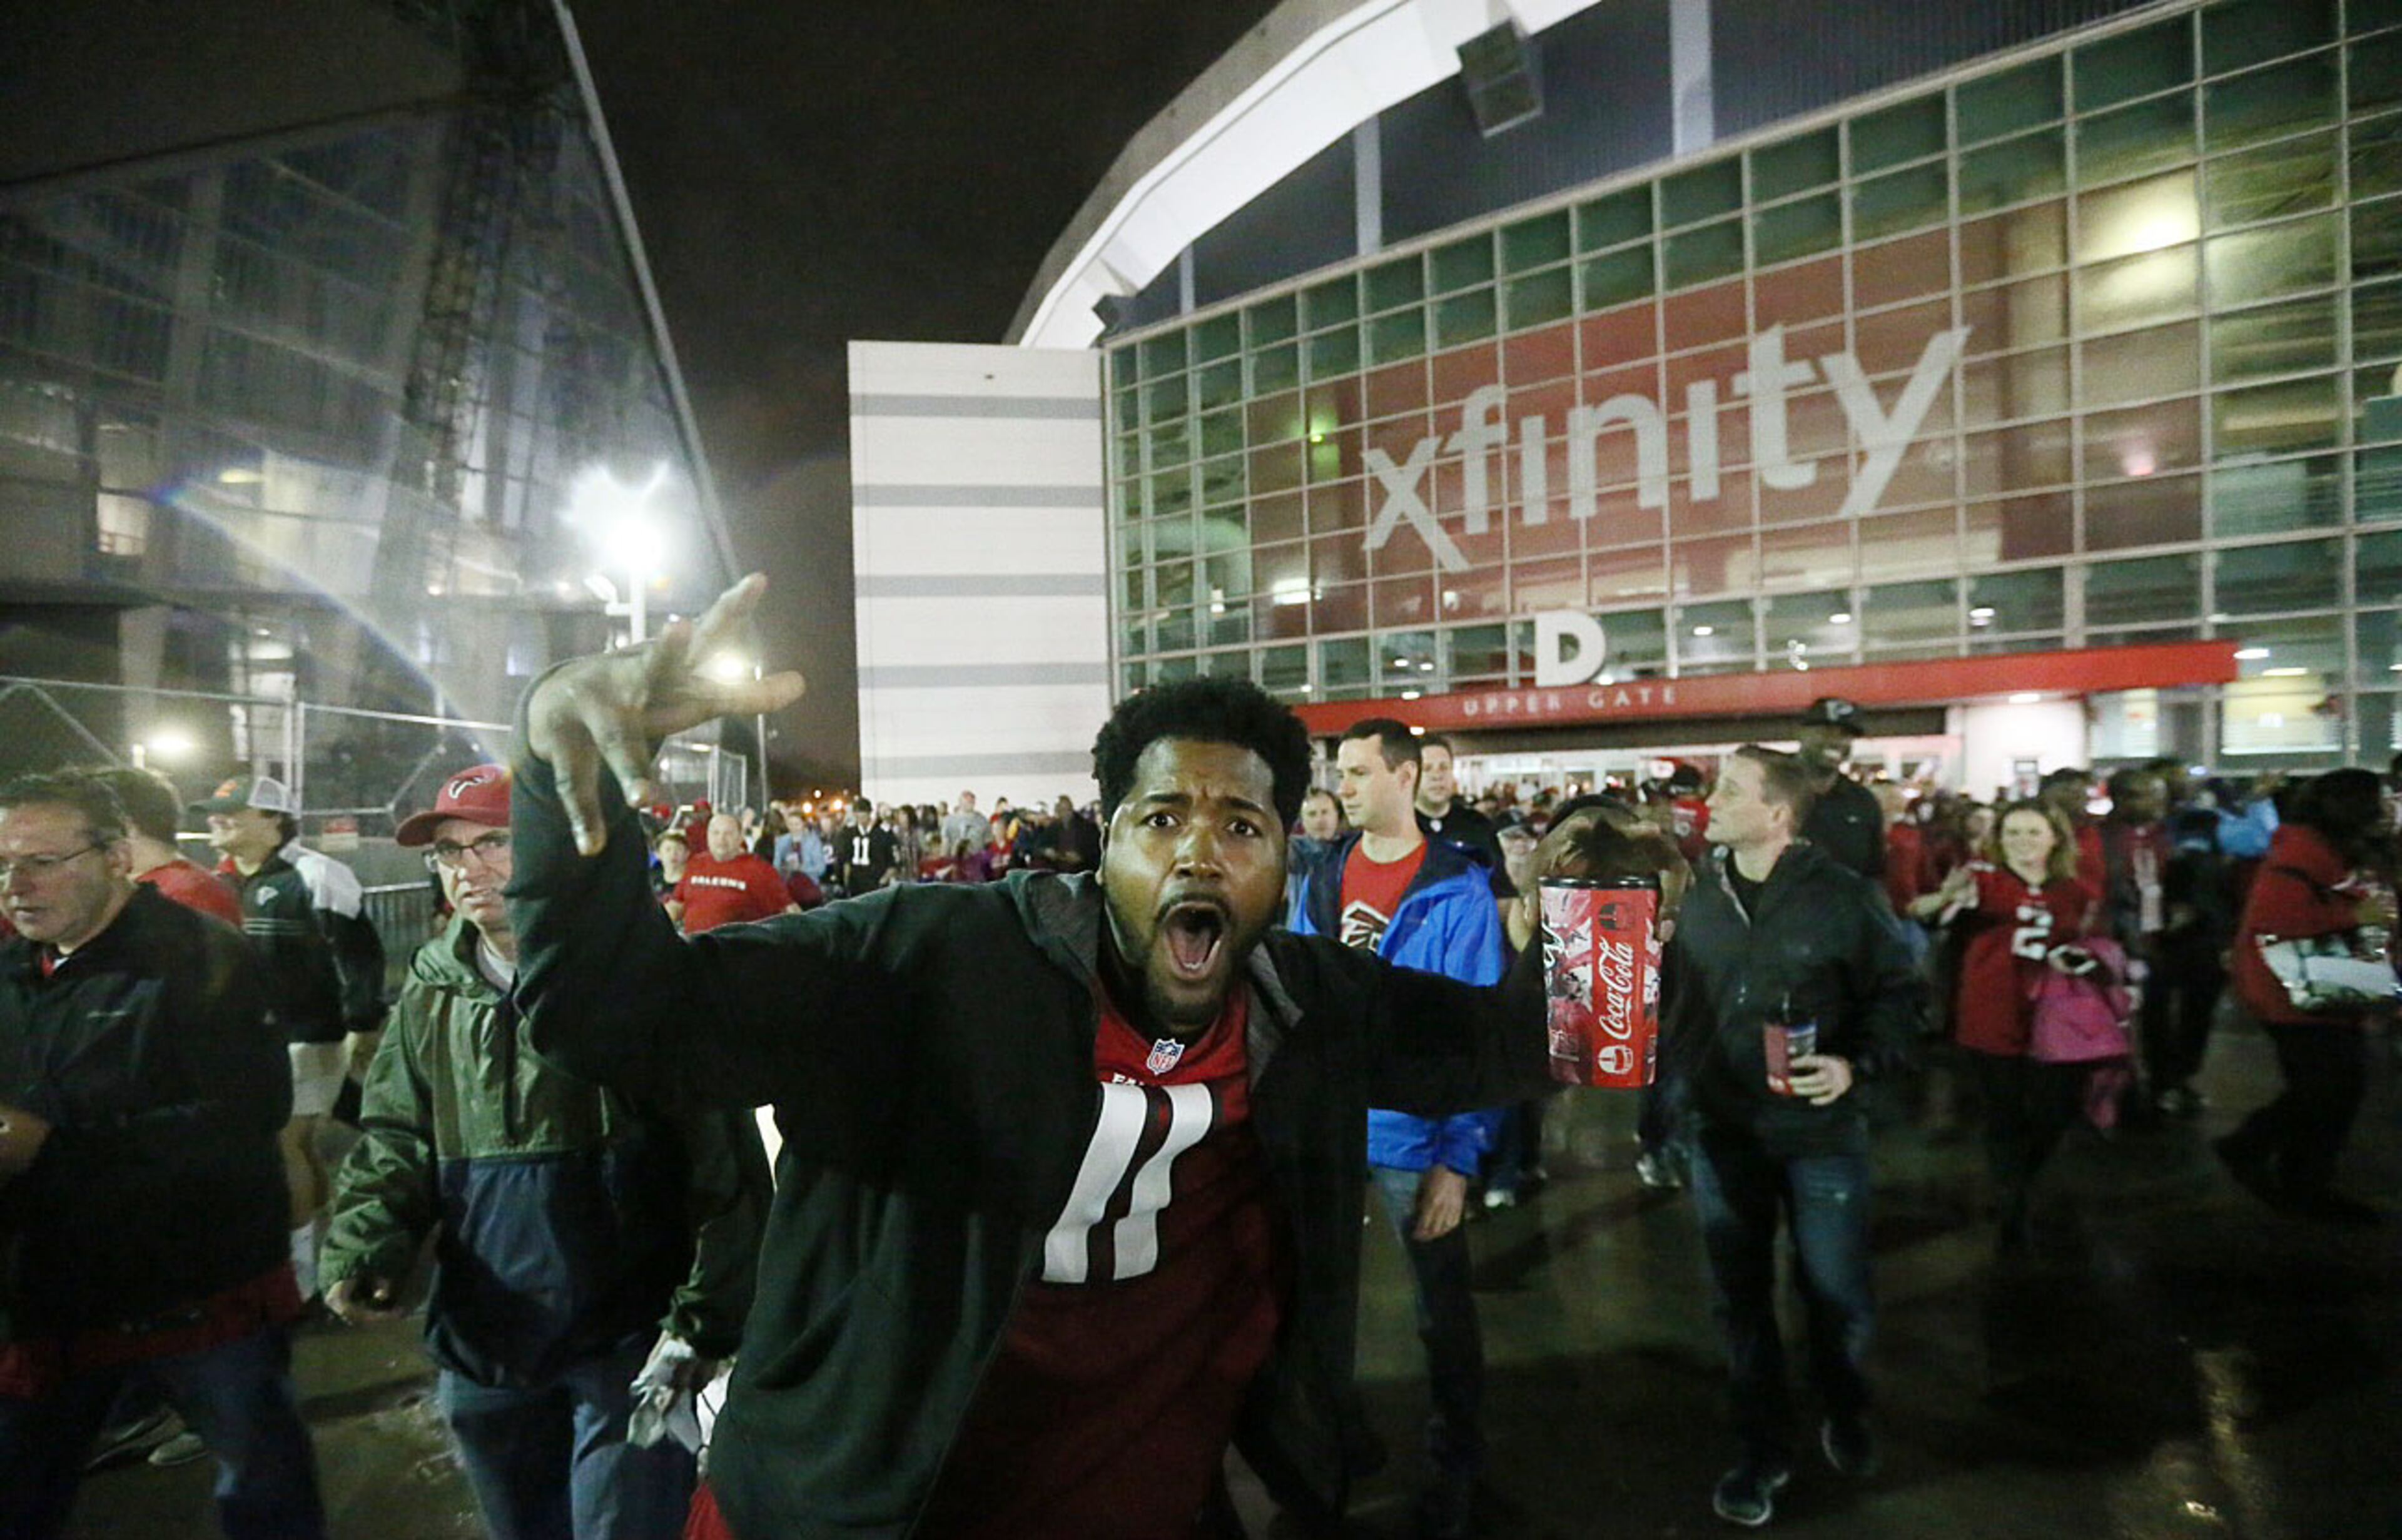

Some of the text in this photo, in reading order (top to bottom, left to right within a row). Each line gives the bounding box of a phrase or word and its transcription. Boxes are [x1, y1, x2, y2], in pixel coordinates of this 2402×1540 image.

[1361, 322, 1974, 572] xfinity
[1534, 609, 1606, 687] D
[1463, 687, 1675, 716] UPPER GATE
[852, 836, 869, 864] 11
[1040, 1082, 1213, 1284] 11
